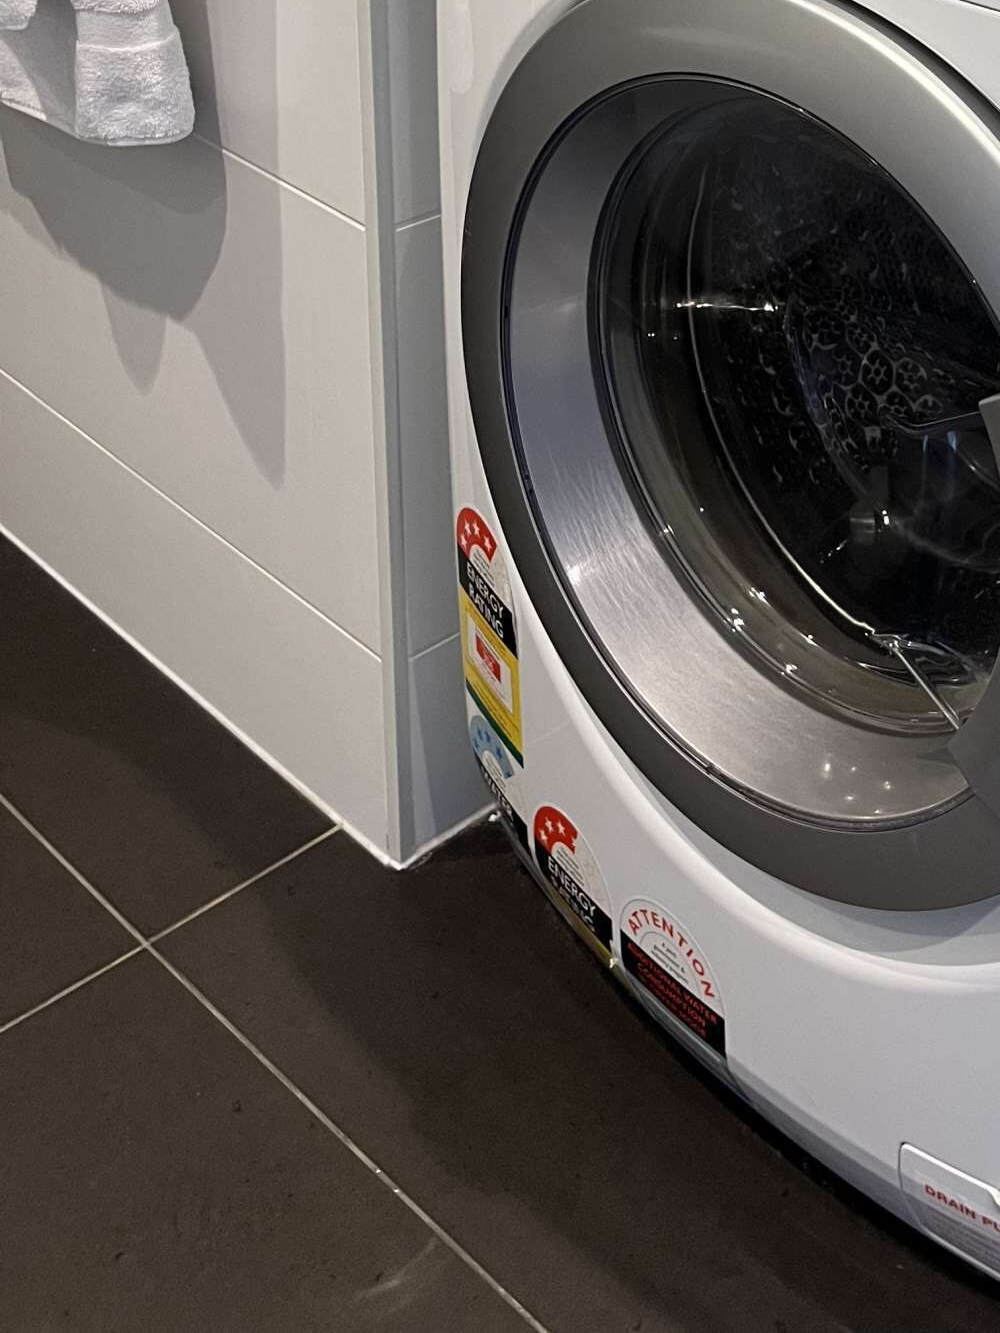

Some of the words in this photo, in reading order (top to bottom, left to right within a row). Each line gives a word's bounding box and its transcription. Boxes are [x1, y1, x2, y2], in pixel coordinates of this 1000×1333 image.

[466, 561, 504, 618] ENERGY
[469, 584, 504, 639] RATING
[548, 856, 597, 917] ENERGY
[628, 909, 715, 998] ATTENTION
[924, 1184, 977, 1220] DRAIN
